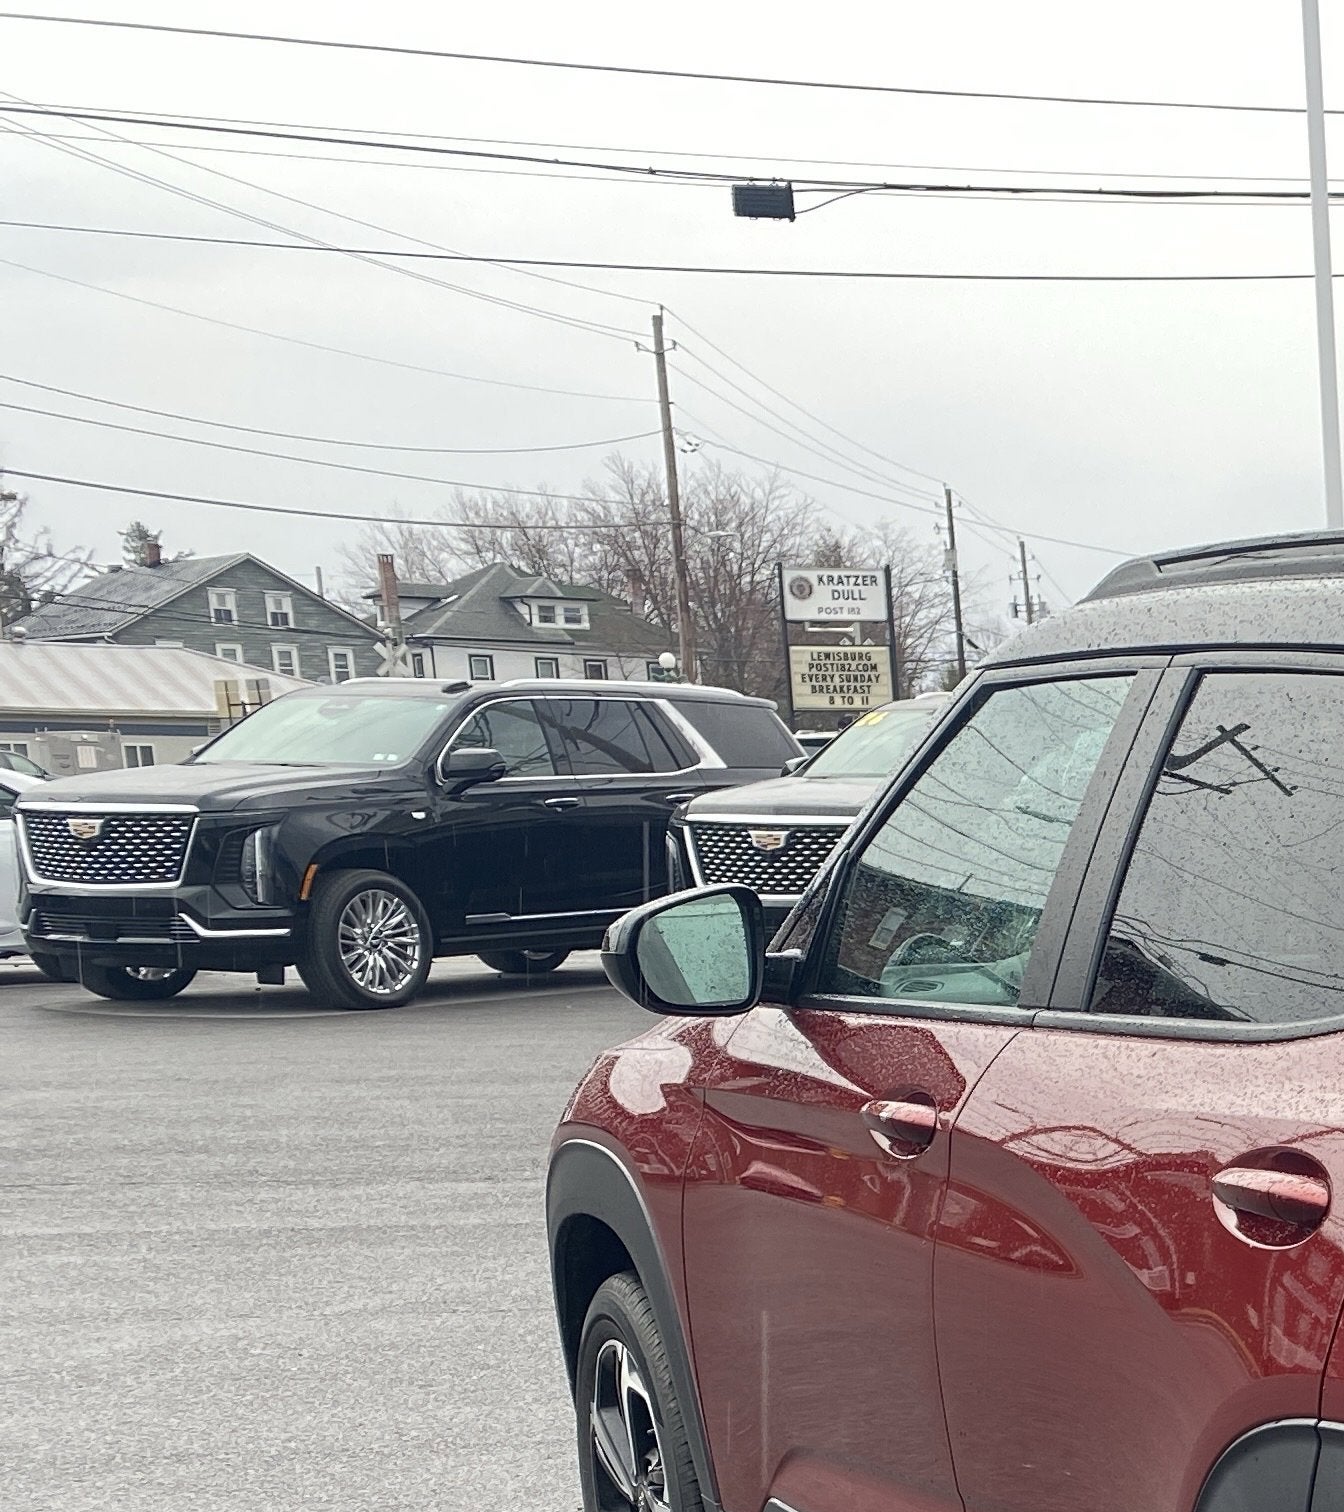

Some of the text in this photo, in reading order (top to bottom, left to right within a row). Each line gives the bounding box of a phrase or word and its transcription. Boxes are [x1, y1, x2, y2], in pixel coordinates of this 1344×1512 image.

[816, 574, 879, 587] KRATZER
[831, 588, 867, 601] DULL
[817, 606, 862, 616] POST 182
[810, 651, 872, 662] LEWISBURG
[808, 662, 878, 673] POST182.COM
[801, 673, 881, 684] EVERY SUNDAY
[810, 684, 872, 695] BREAKFAST
[840, 695, 855, 706] TO
